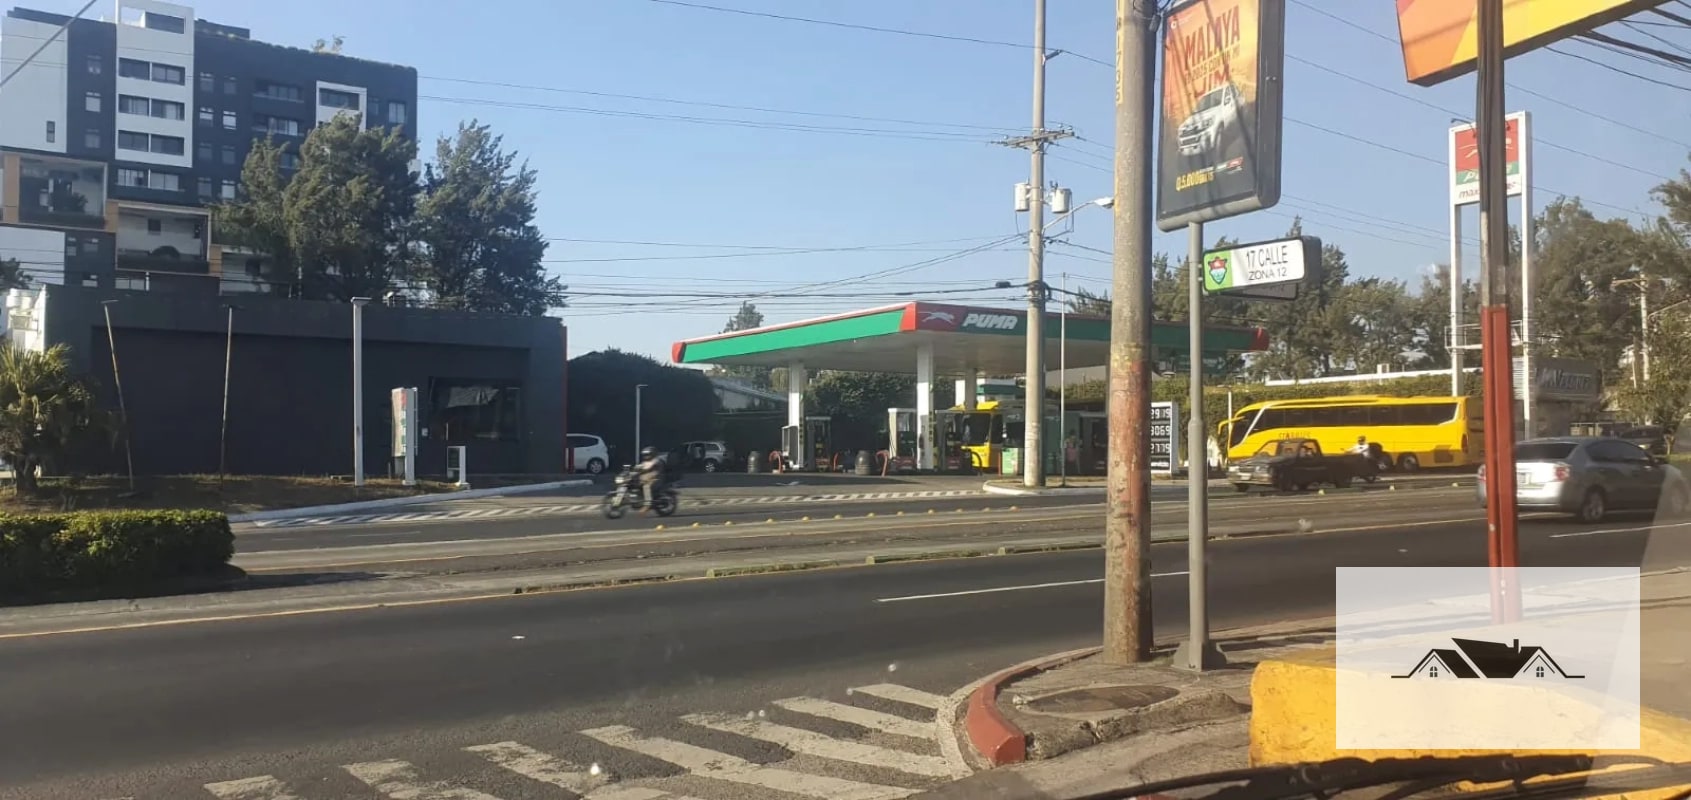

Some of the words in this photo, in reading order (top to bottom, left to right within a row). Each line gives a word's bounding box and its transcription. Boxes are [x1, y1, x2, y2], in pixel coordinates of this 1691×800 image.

[1184, 4, 1240, 72] MALAYA
[1246, 250, 1256, 268] 17
[1258, 245, 1288, 267] CALLE
[1248, 269, 1275, 280] ZONA
[1277, 266, 1288, 278] 12
[962, 313, 1018, 330] PUMA
